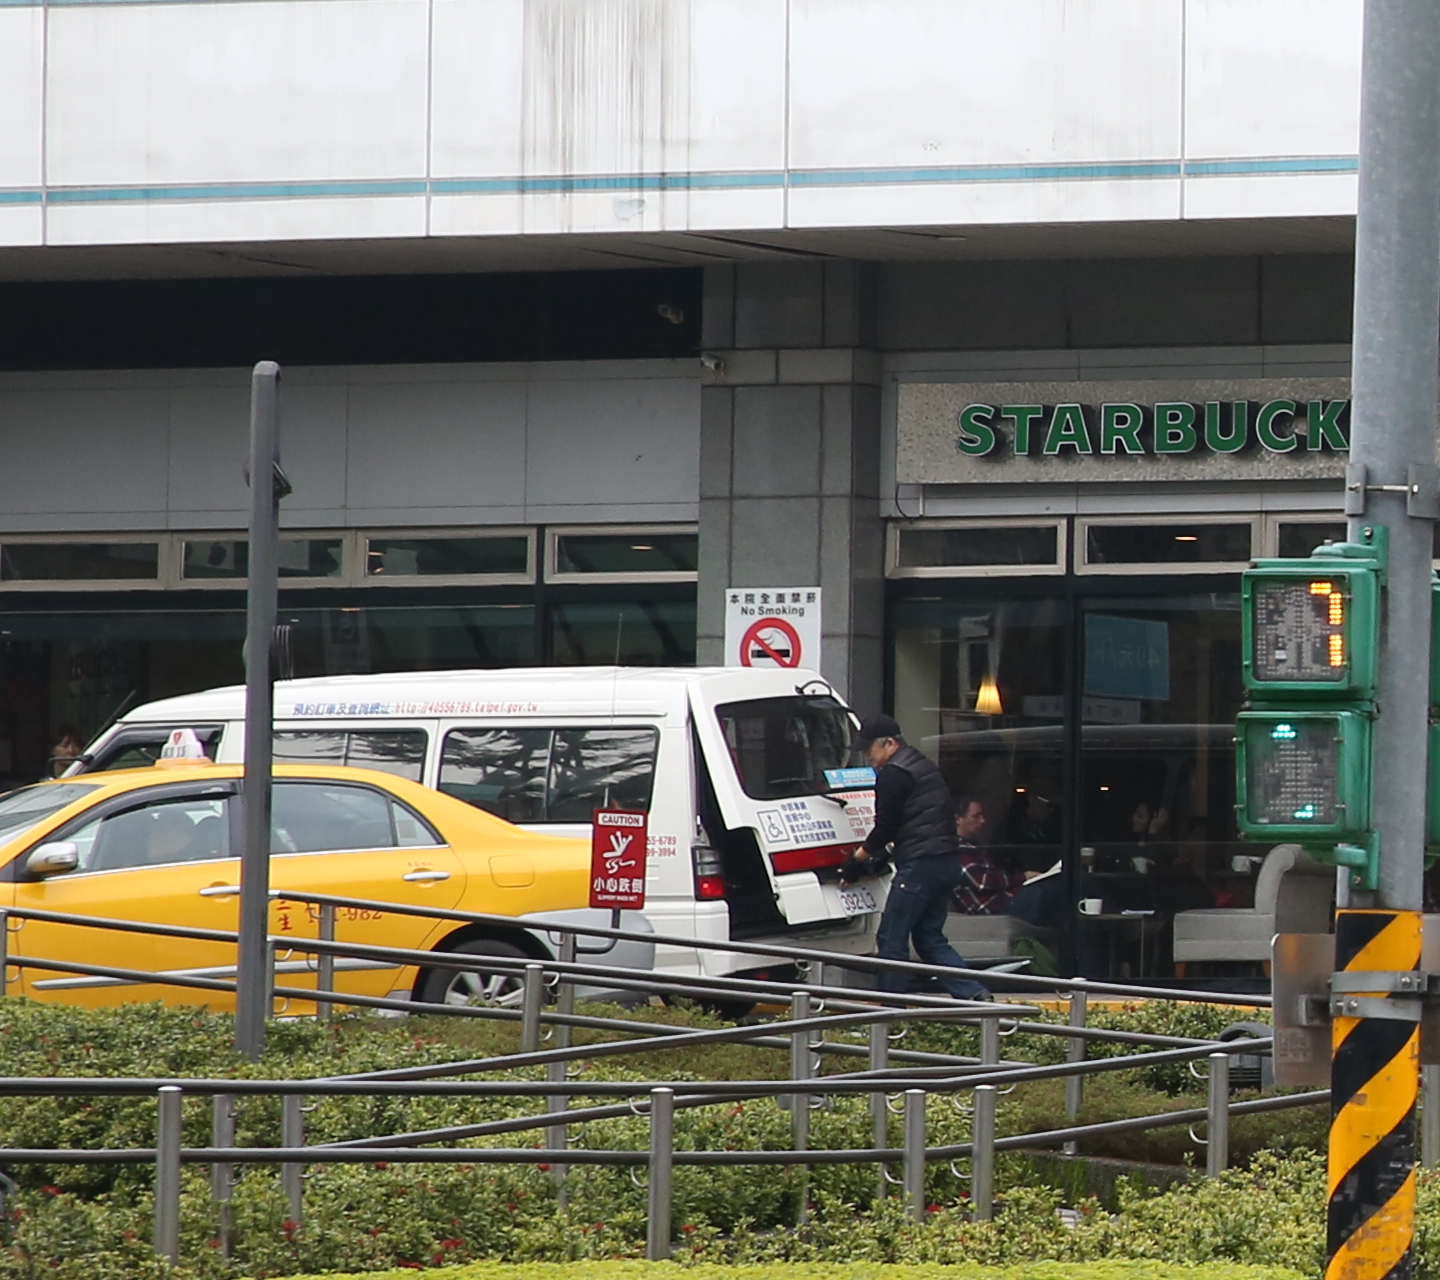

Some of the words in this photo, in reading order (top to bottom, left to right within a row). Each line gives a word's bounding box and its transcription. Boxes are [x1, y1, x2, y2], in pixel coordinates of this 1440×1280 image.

[955, 397, 1351, 457] STARBUCK
[741, 606, 755, 616] No
[758, 605, 805, 617] Smoking
[601, 815, 641, 825] CAUTION
